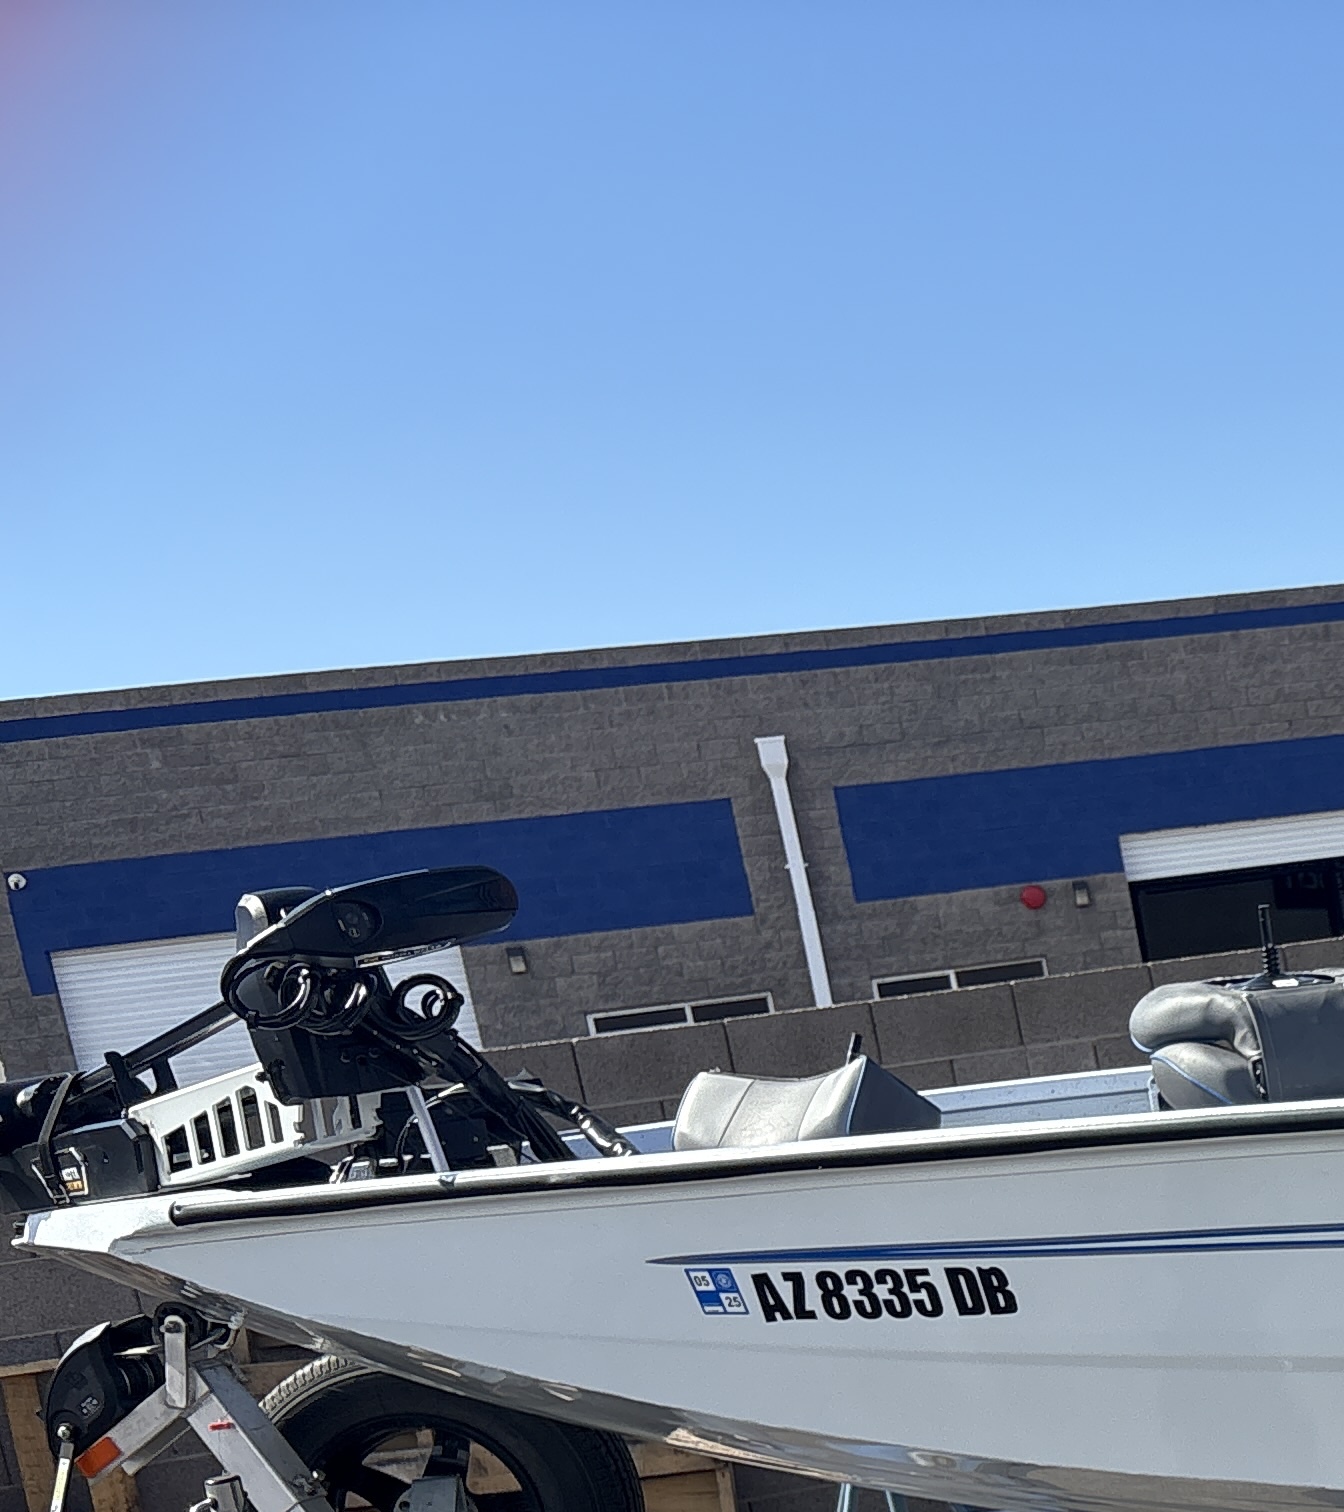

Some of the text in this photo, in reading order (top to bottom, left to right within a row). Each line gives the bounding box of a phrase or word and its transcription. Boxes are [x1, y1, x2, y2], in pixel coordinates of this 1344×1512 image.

[693, 1275, 710, 1287] 05
[751, 1266, 1018, 1322] AZ 8335 DB
[725, 1296, 742, 1308] 25
